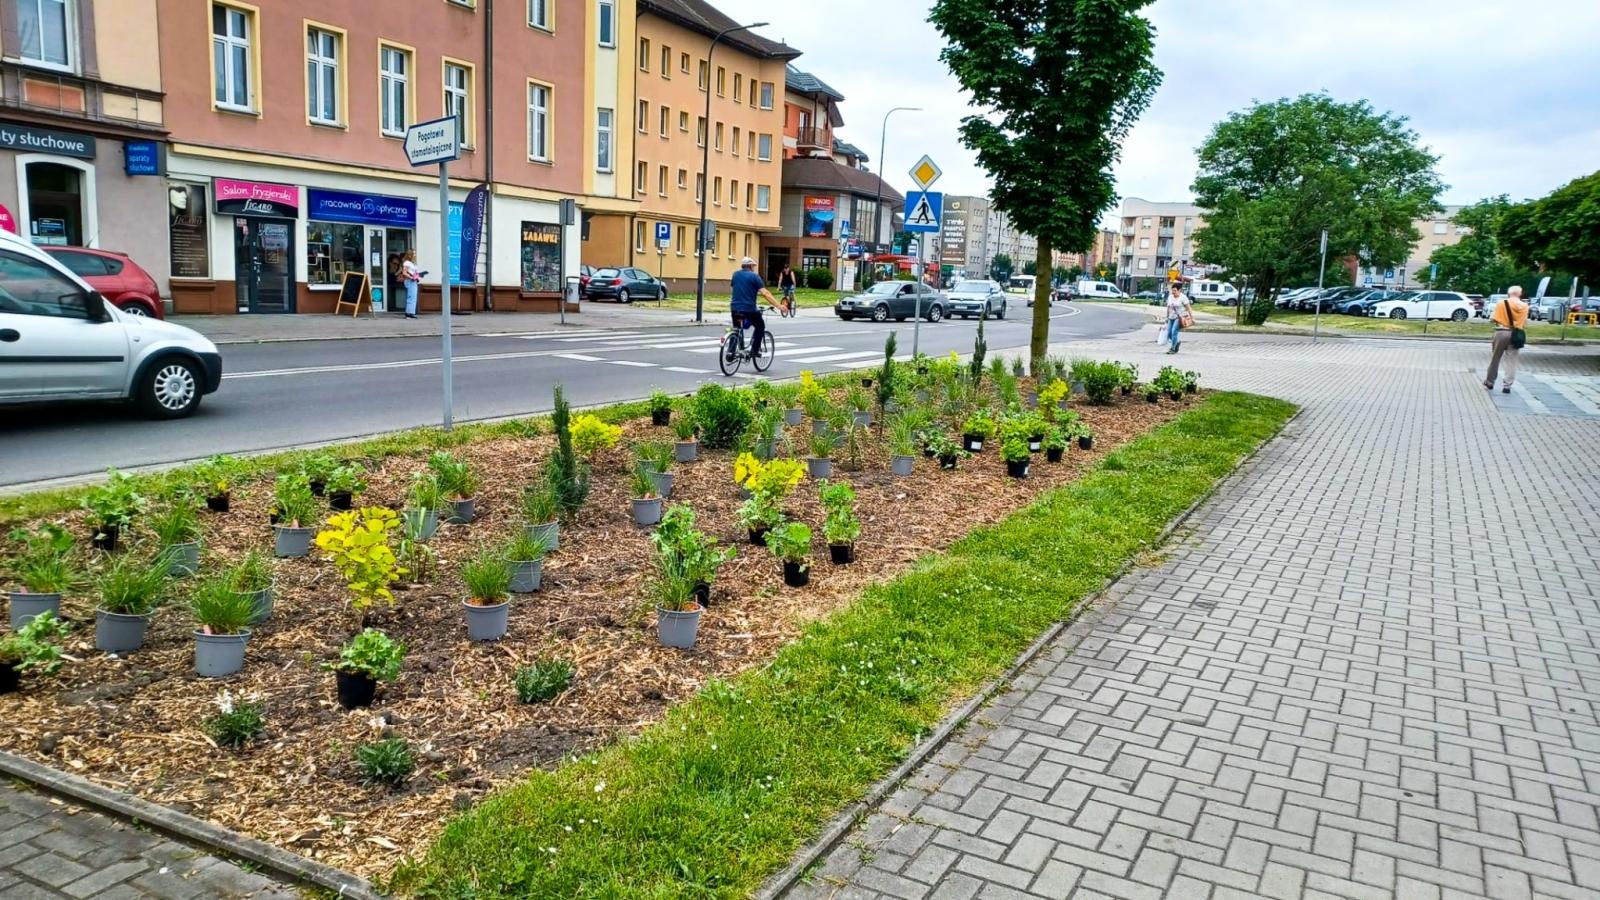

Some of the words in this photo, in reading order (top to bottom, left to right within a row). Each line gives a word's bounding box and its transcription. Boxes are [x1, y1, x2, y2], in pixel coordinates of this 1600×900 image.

[20, 132, 85, 152] słuchowe
[417, 129, 444, 143] Pogotowie
[411, 143, 452, 158] stomatologiczne
[223, 186, 248, 196] Salon
[252, 185, 291, 200] fryzjerski
[319, 200, 362, 210] pracownia
[375, 204, 408, 215] optyczna
[658, 224, 668, 238] P
